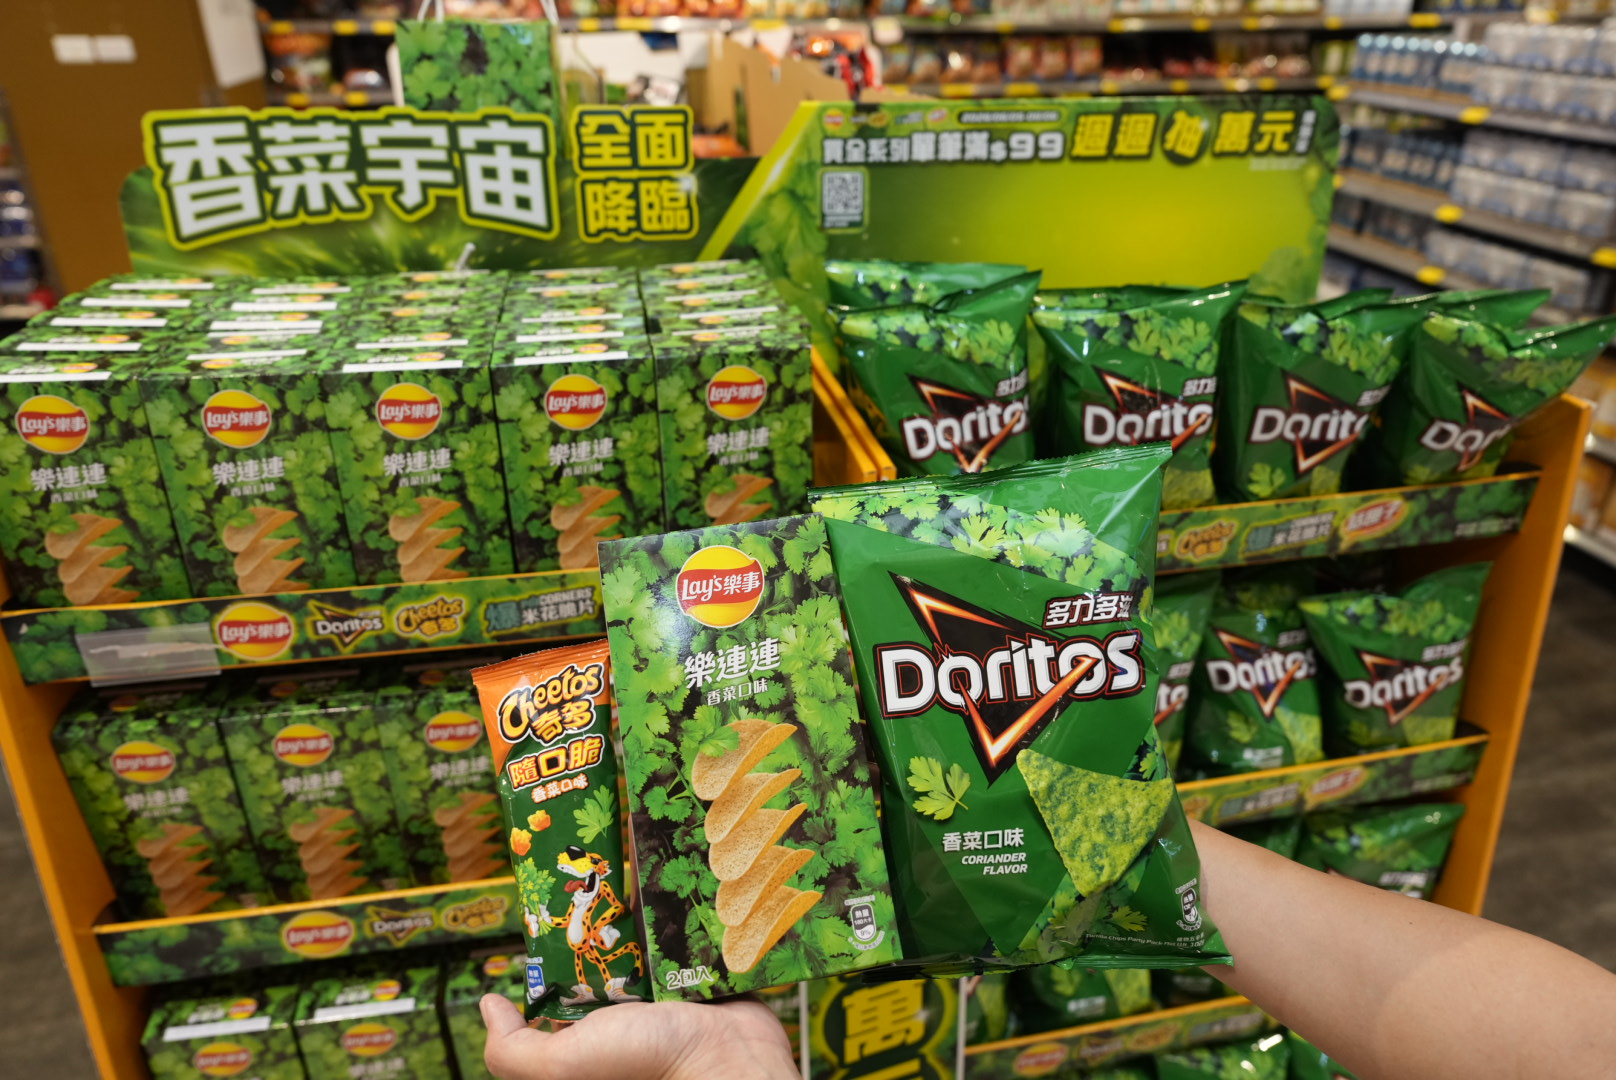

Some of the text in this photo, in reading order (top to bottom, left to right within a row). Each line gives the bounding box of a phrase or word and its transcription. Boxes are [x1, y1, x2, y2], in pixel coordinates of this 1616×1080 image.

[580, 112, 687, 170] 全面
[158, 121, 550, 239] 香菜宇宙
[584, 179, 692, 233] 降臨
[903, 396, 1028, 459] Dorito
[1084, 402, 1213, 444] Dorito
[1250, 408, 1370, 442] Dorit
[31, 462, 107, 491] 樂連連
[316, 616, 383, 636] Doritos
[684, 637, 781, 689] 樂連連
[881, 634, 1140, 713] Doritos
[499, 664, 602, 740] Cheetos
[707, 677, 768, 706] 香菜口味
[532, 699, 593, 742] 奇多
[510, 737, 603, 789] 隨口脆
[531, 774, 588, 802] 香菜口味
[942, 827, 1025, 853] 香菜口味
[961, 852, 1027, 865] CORIANDER
[982, 863, 1028, 876] FLAVOR
[665, 965, 714, 990] 2包入
